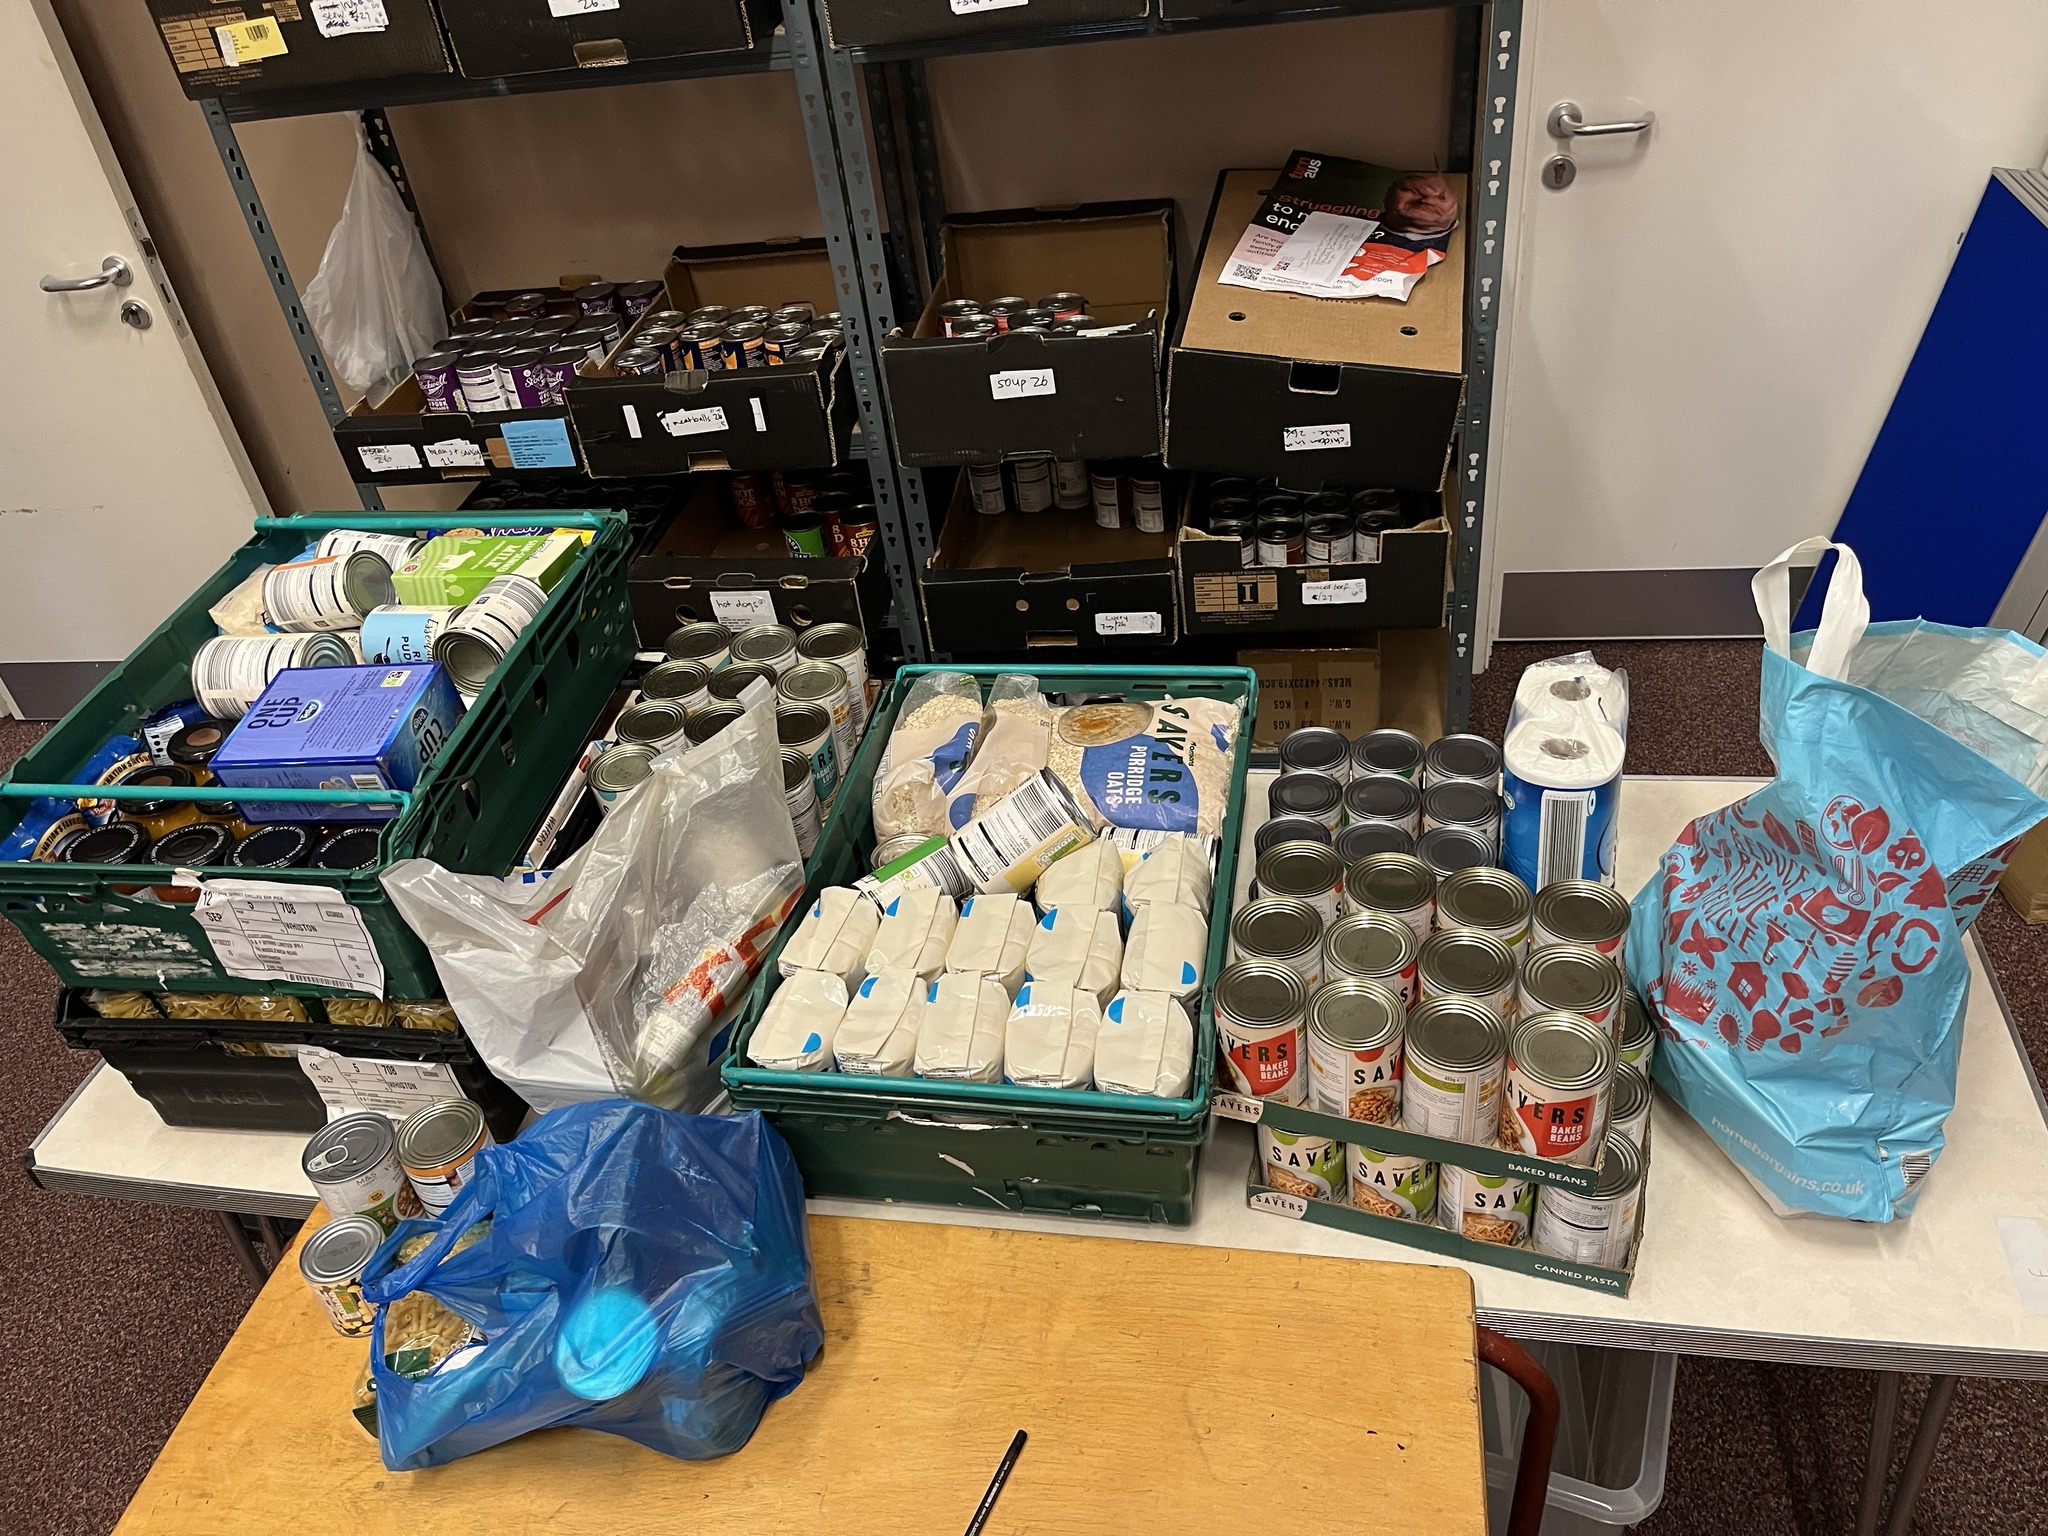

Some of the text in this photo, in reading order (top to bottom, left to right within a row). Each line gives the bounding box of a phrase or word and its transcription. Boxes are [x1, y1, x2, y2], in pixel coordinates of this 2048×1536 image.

[1289, 157, 1311, 180] turn
[1272, 202, 1294, 215] to
[1278, 194, 1381, 219] struggling
[997, 376, 1048, 393] soup 26
[672, 415, 711, 427] meatballs
[715, 599, 759, 613] hot dogs
[247, 697, 284, 729] ONE
[268, 696, 304, 728] CUP
[1273, 699, 1291, 709] KGS
[1273, 720, 1291, 730] KGS
[419, 718, 444, 764] CUP
[1147, 704, 1190, 804] SAVERS
[1125, 745, 1148, 804] PORRIDGE
[1105, 771, 1125, 805] OATS
[537, 815, 558, 847] WAFERS
[1730, 824, 1811, 896] REDUCE
[202, 890, 213, 907] 12
[281, 902, 297, 915] 708
[205, 912, 222, 923] SEP
[284, 922, 318, 933] WHISTON
[1702, 883, 1756, 954] RECYCLE
[1216, 1026, 1288, 1062] AVERS
[354, 1063, 360, 1073] 5
[381, 1064, 397, 1076] 708
[1260, 1060, 1289, 1072] BAKED
[1261, 1067, 1289, 1080] BEANS
[1353, 1055, 1397, 1085] SAV
[1211, 1098, 1260, 1116] SAVERS
[1507, 1079, 1586, 1125] AVERS
[1550, 1133, 1582, 1143] BEANS
[1551, 1124, 1583, 1134] BAKED
[1272, 1140, 1344, 1167] SAVER
[1711, 1114, 1866, 1196] homebargains.co.uk
[355, 1172, 377, 1187] M&S
[1358, 1161, 1433, 1187] SAVER
[1508, 1163, 1588, 1187] BAKED BEANS
[1255, 1194, 1304, 1212] SAVERS
[1534, 1264, 1620, 1288] CANNED PASTA
